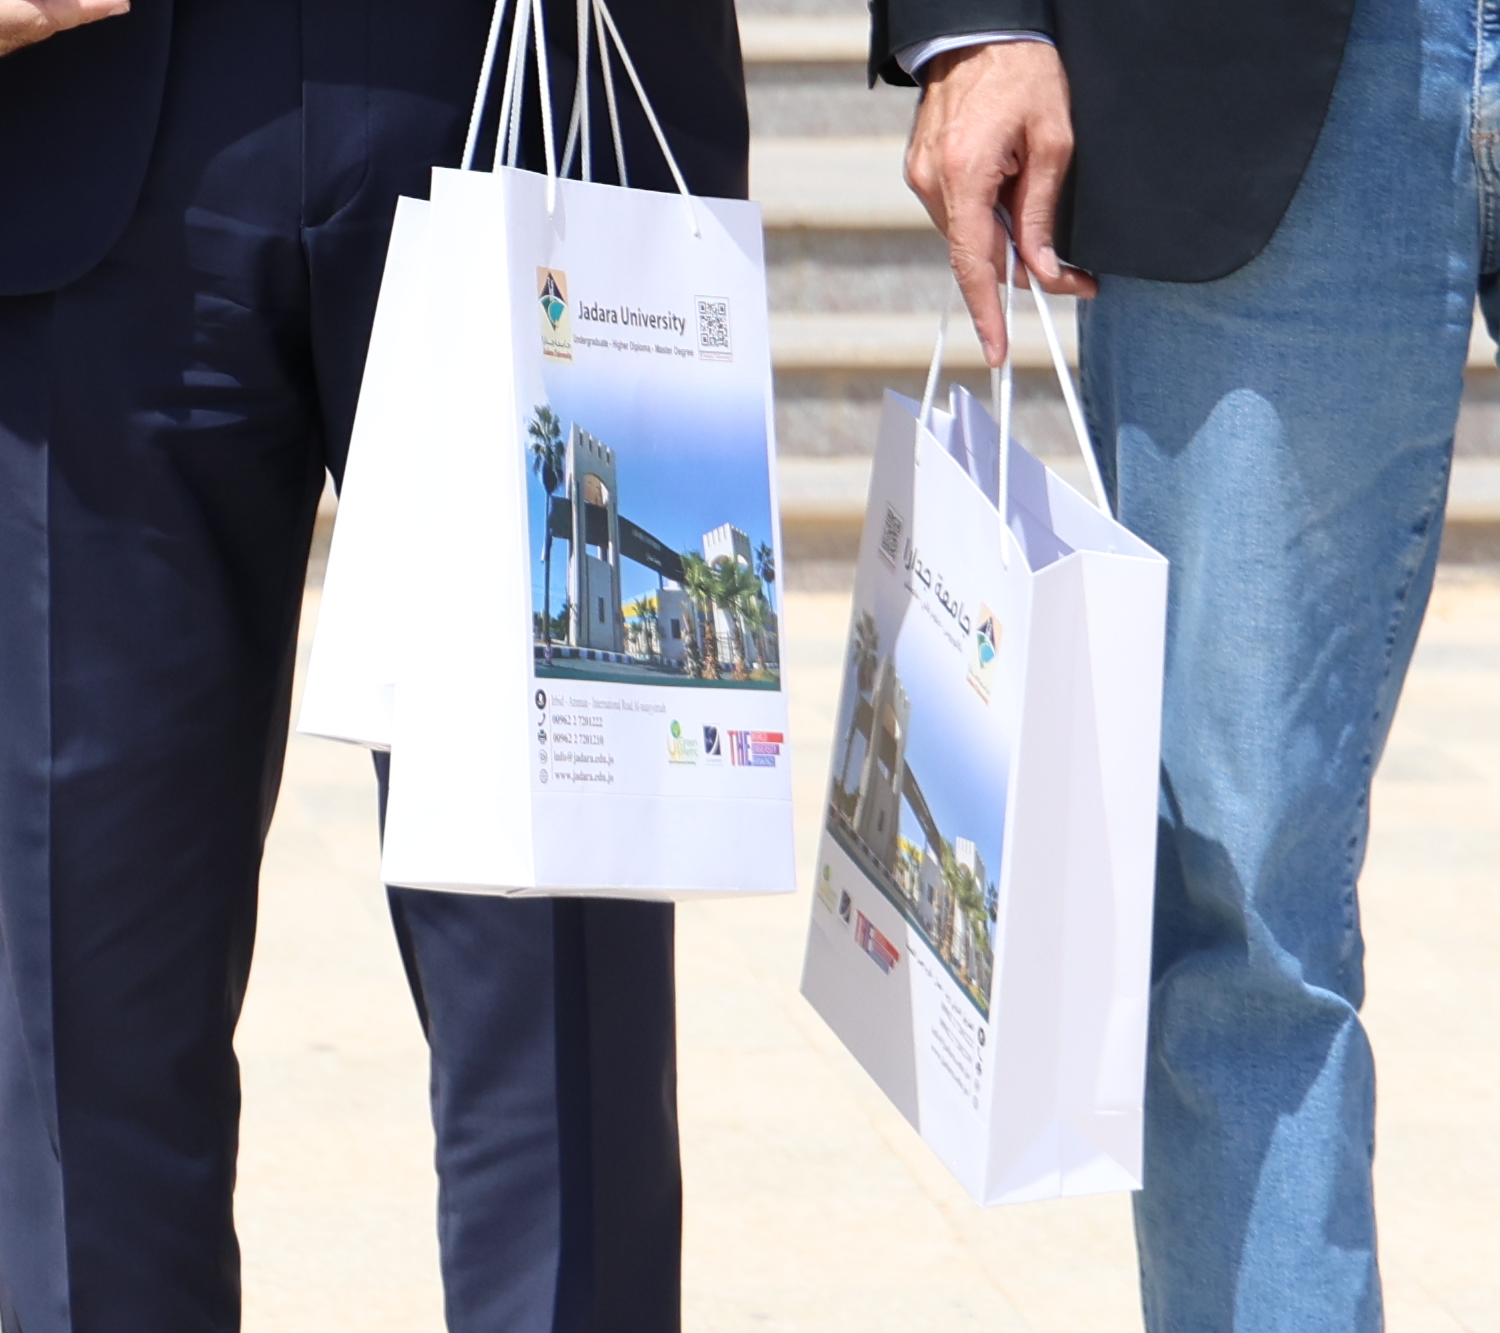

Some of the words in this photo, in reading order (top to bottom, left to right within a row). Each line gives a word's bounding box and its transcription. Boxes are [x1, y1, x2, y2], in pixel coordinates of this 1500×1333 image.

[578, 300, 618, 325] Jadara
[620, 305, 686, 336] University
[903, 537, 932, 592] جدارا
[935, 573, 971, 639] جامعة
[727, 730, 752, 766] THE
